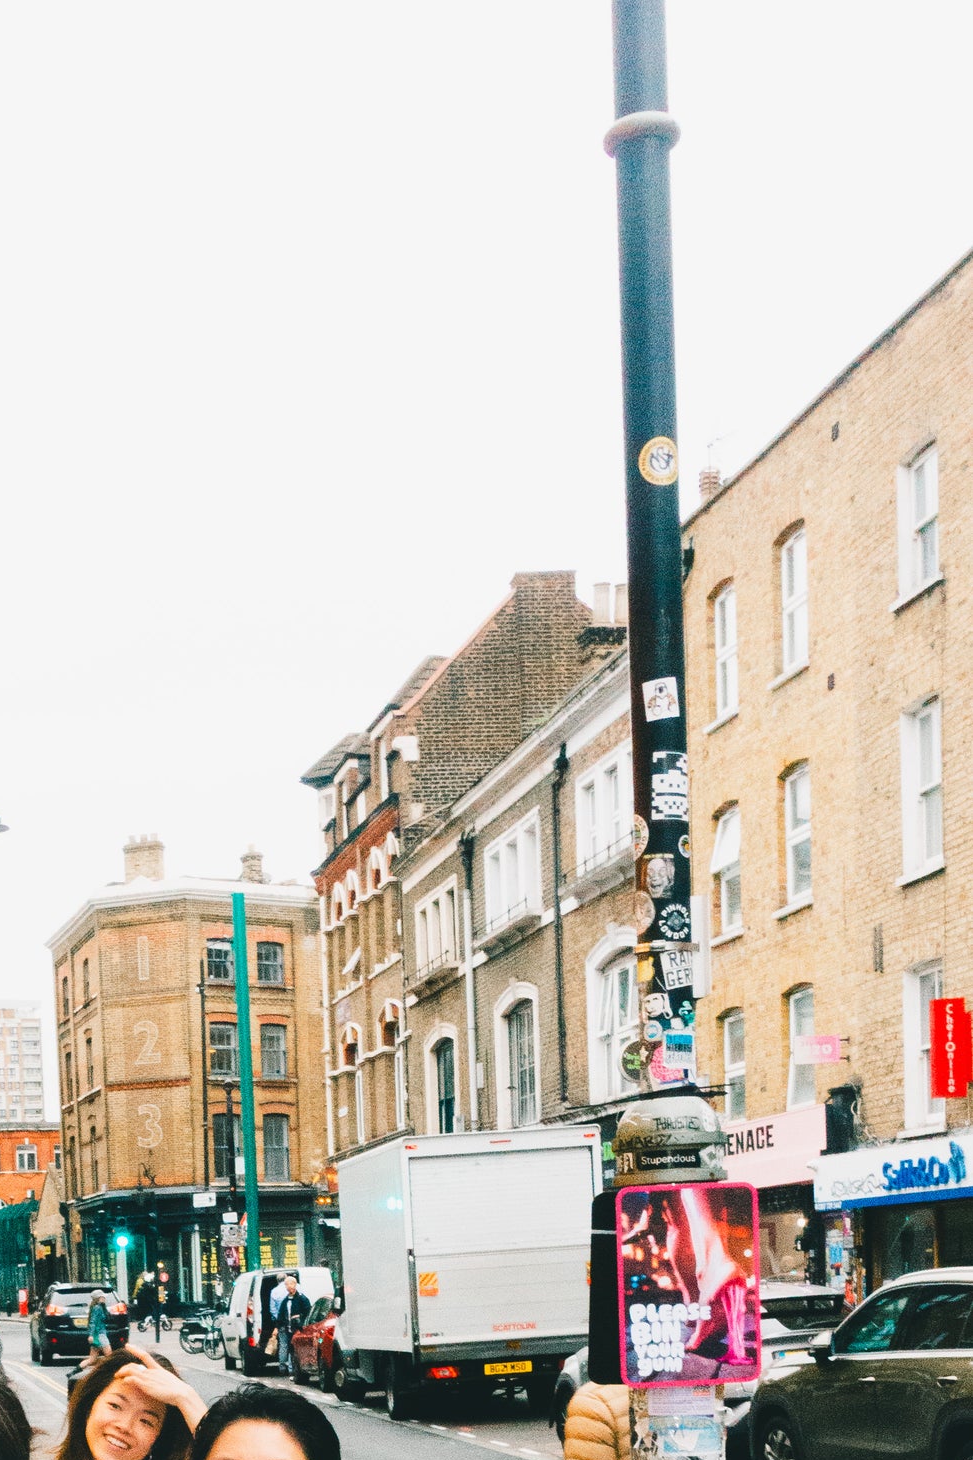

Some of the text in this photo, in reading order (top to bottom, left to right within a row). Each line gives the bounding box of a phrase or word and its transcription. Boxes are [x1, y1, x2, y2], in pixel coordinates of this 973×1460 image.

[658, 920, 689, 939] LONDON
[133, 1020, 162, 1065] 2
[137, 1103, 164, 1150] 3
[723, 1125, 774, 1156] ENACE
[641, 1154, 696, 1166] Stupendous
[629, 1303, 711, 1323] PLEASE
[631, 1321, 681, 1345] BIN
[634, 1342, 685, 1360] YOUR
